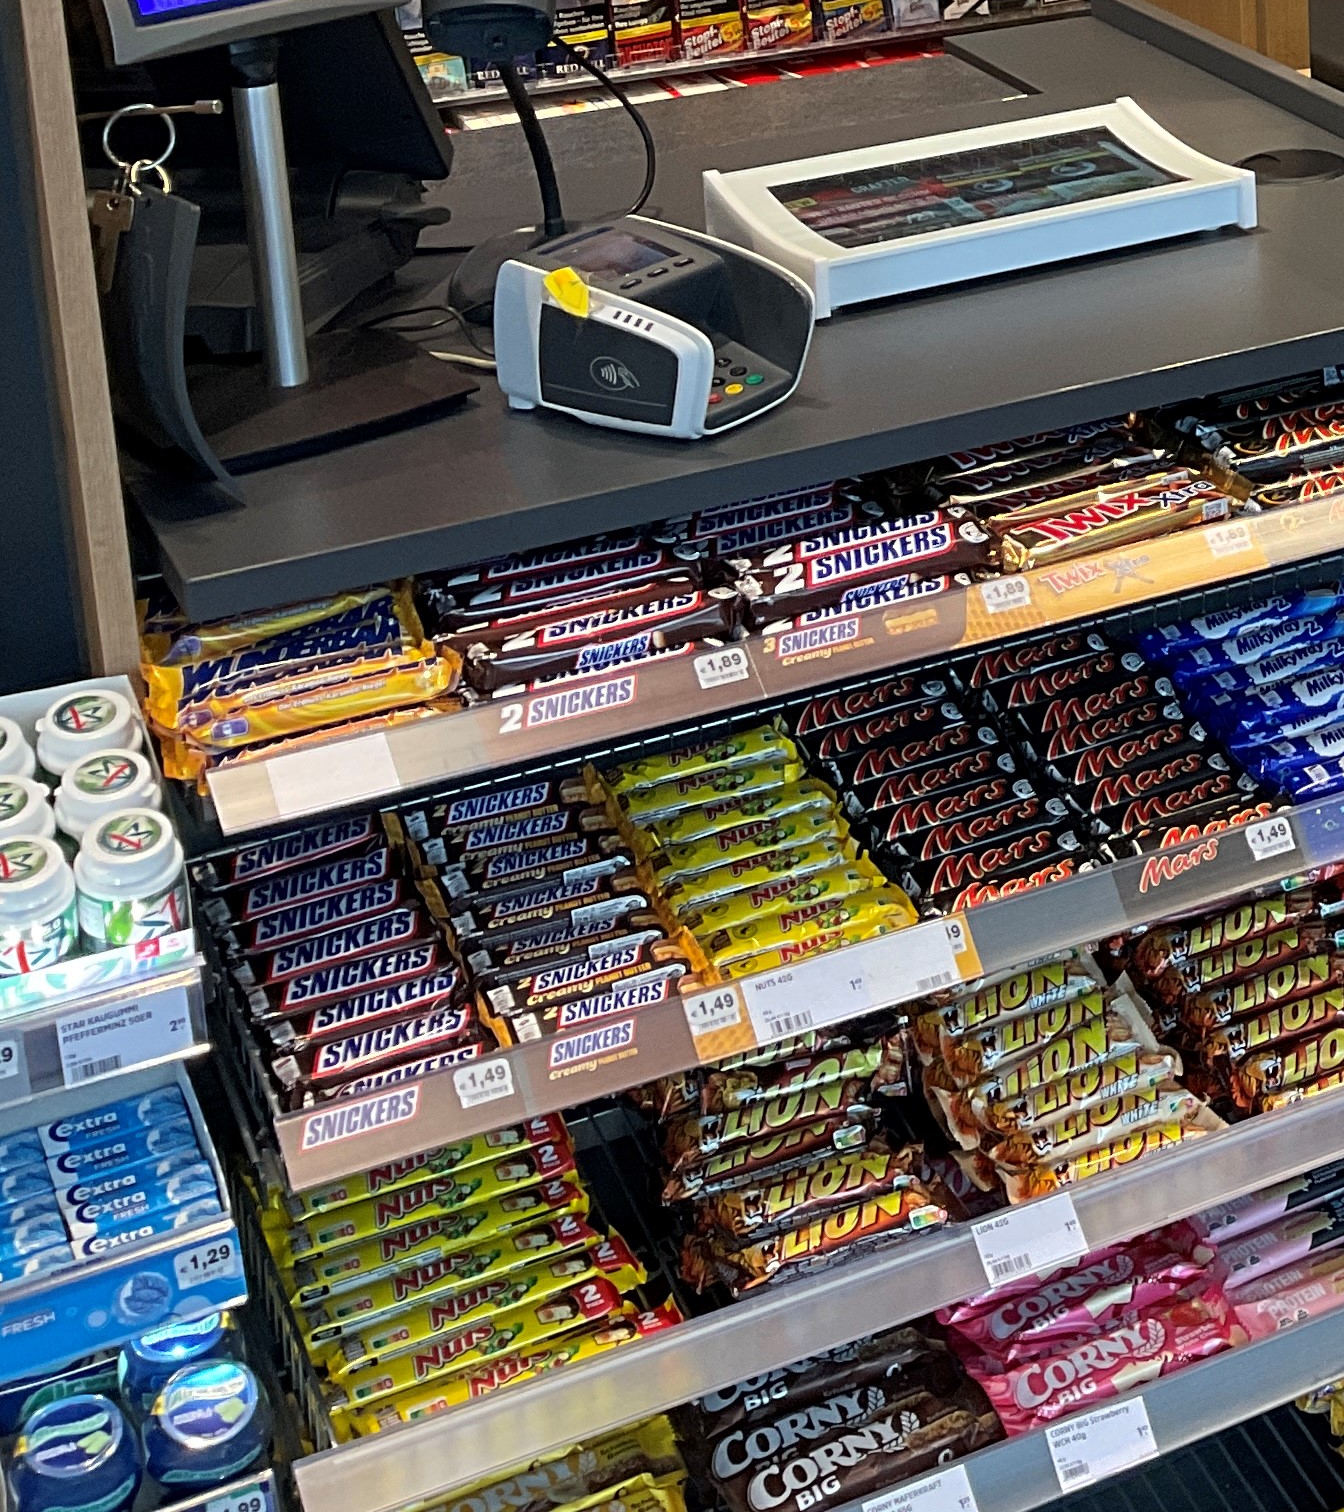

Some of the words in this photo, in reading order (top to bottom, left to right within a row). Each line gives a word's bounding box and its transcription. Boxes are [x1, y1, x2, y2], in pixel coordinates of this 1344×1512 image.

[1014, 490, 1155, 543] Twix
[1158, 481, 1214, 510] Xtra
[774, 562, 804, 594] 2
[815, 524, 948, 582] SNICKERS
[780, 618, 857, 657] SNICKERS
[782, 648, 833, 666] creamy
[501, 706, 523, 734] 2
[528, 675, 636, 727] SNICKERS
[238, 818, 370, 876] SNICKERS
[1140, 837, 1219, 893] Mars
[750, 873, 814, 908] Nuts
[289, 949, 434, 1005] SNICKERS
[61, 1020, 85, 1034] STAR
[86, 1004, 139, 1026] KAUGUMMI
[323, 1010, 468, 1069] SNICKERS
[58, 1110, 117, 1138] extra
[305, 1088, 418, 1147] SNICKERS
[113, 1204, 150, 1221] FRESH
[1269, 1282, 1327, 1320] PROTEIN
[413, 1323, 494, 1378] Nuts
[1016, 1324, 1147, 1410] CORNY
[1056, 1377, 1098, 1406] BIG
